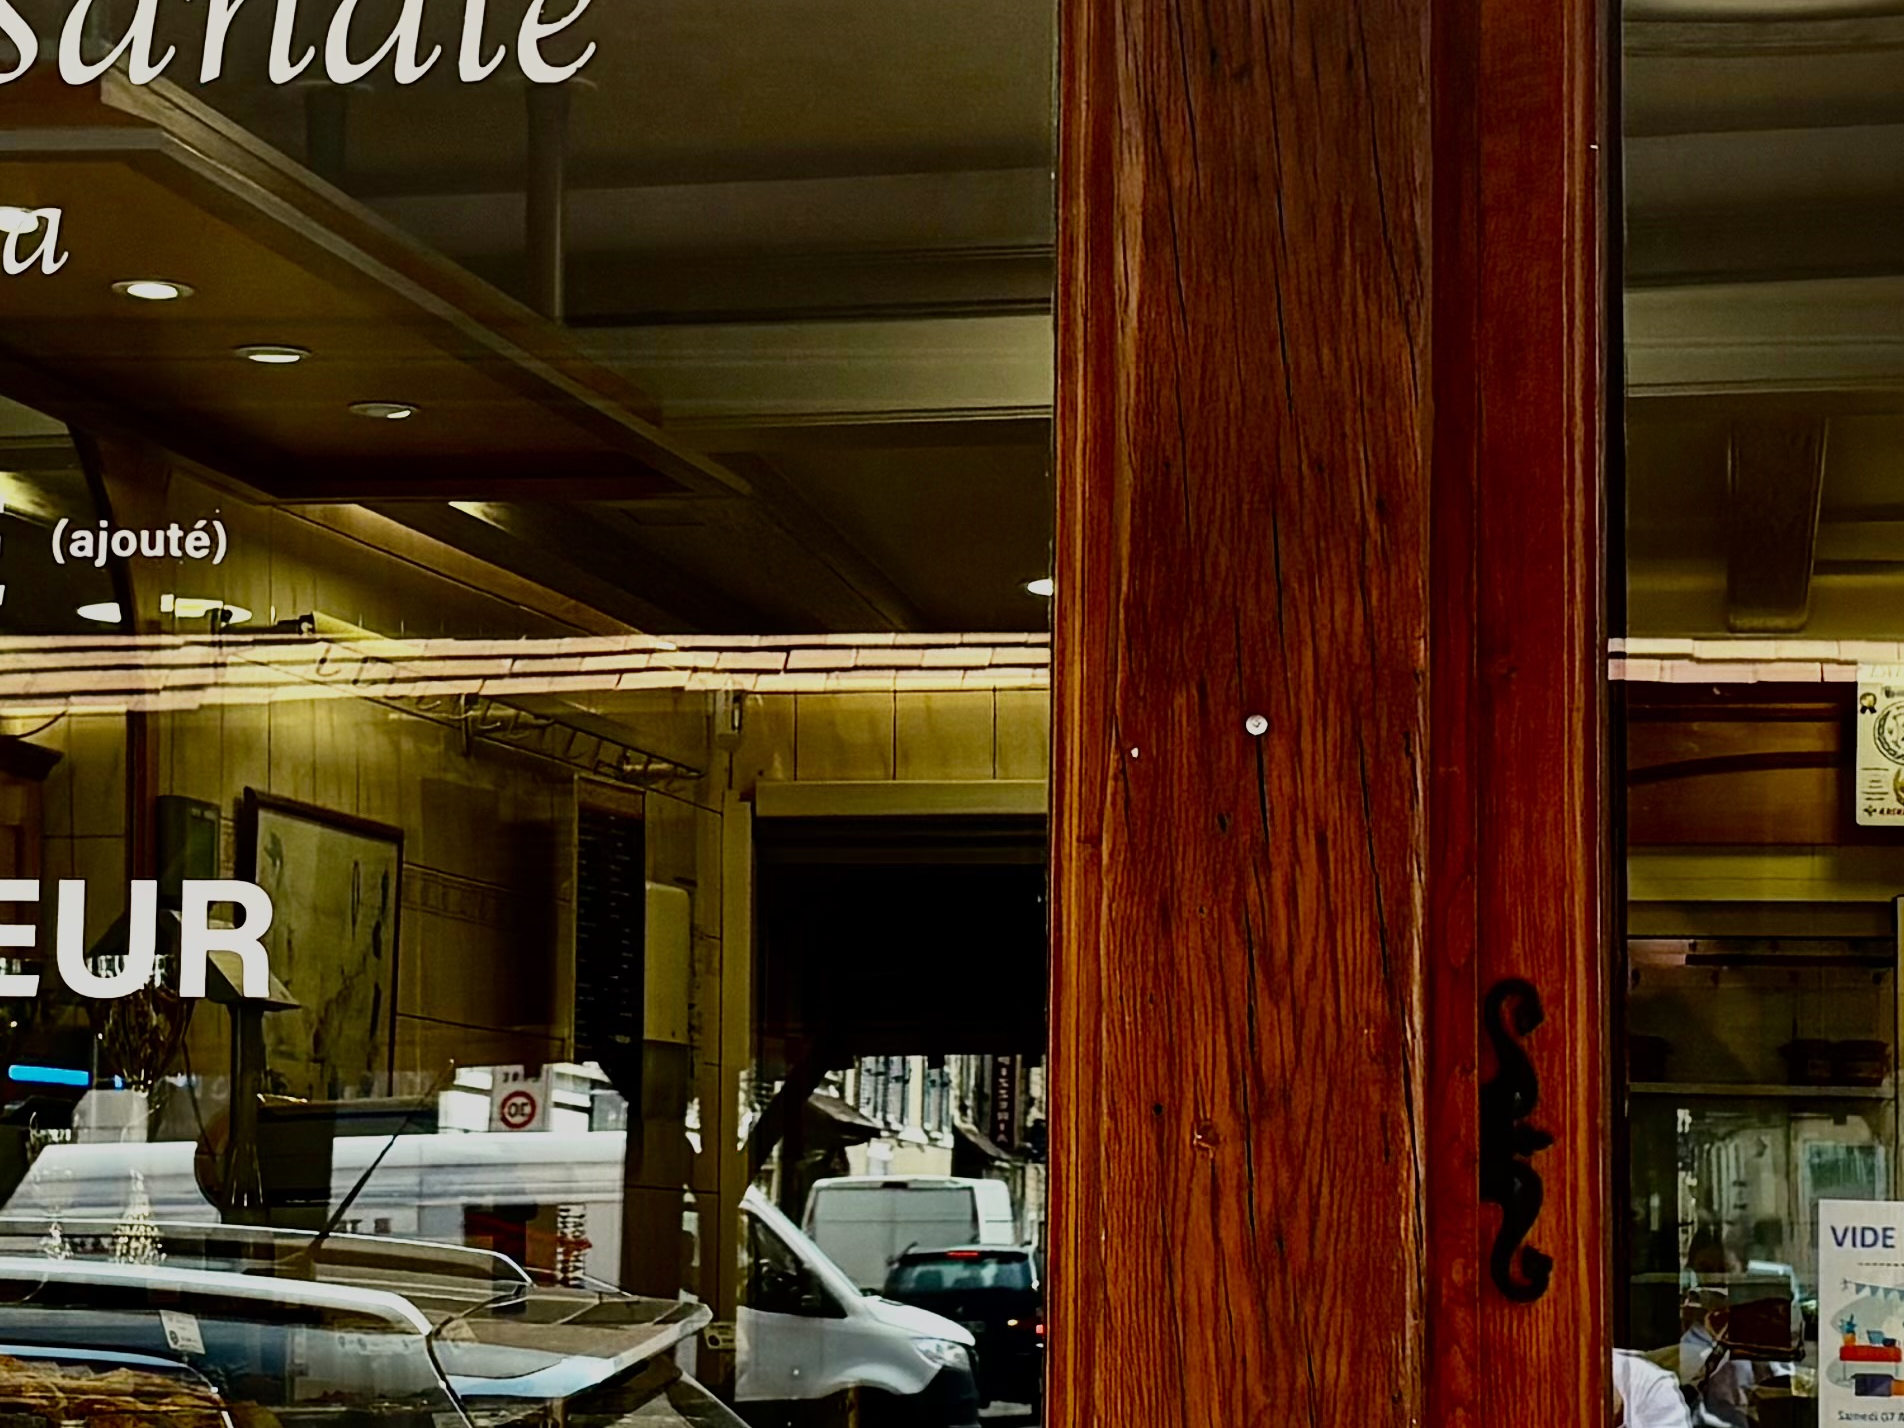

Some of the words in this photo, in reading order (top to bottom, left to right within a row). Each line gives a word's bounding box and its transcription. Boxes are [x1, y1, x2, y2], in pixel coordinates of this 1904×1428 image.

[51, 518, 227, 568] (ajouté)
[1830, 1224, 1896, 1249] VIDE
[1837, 1410, 1878, 1421] Samedi
